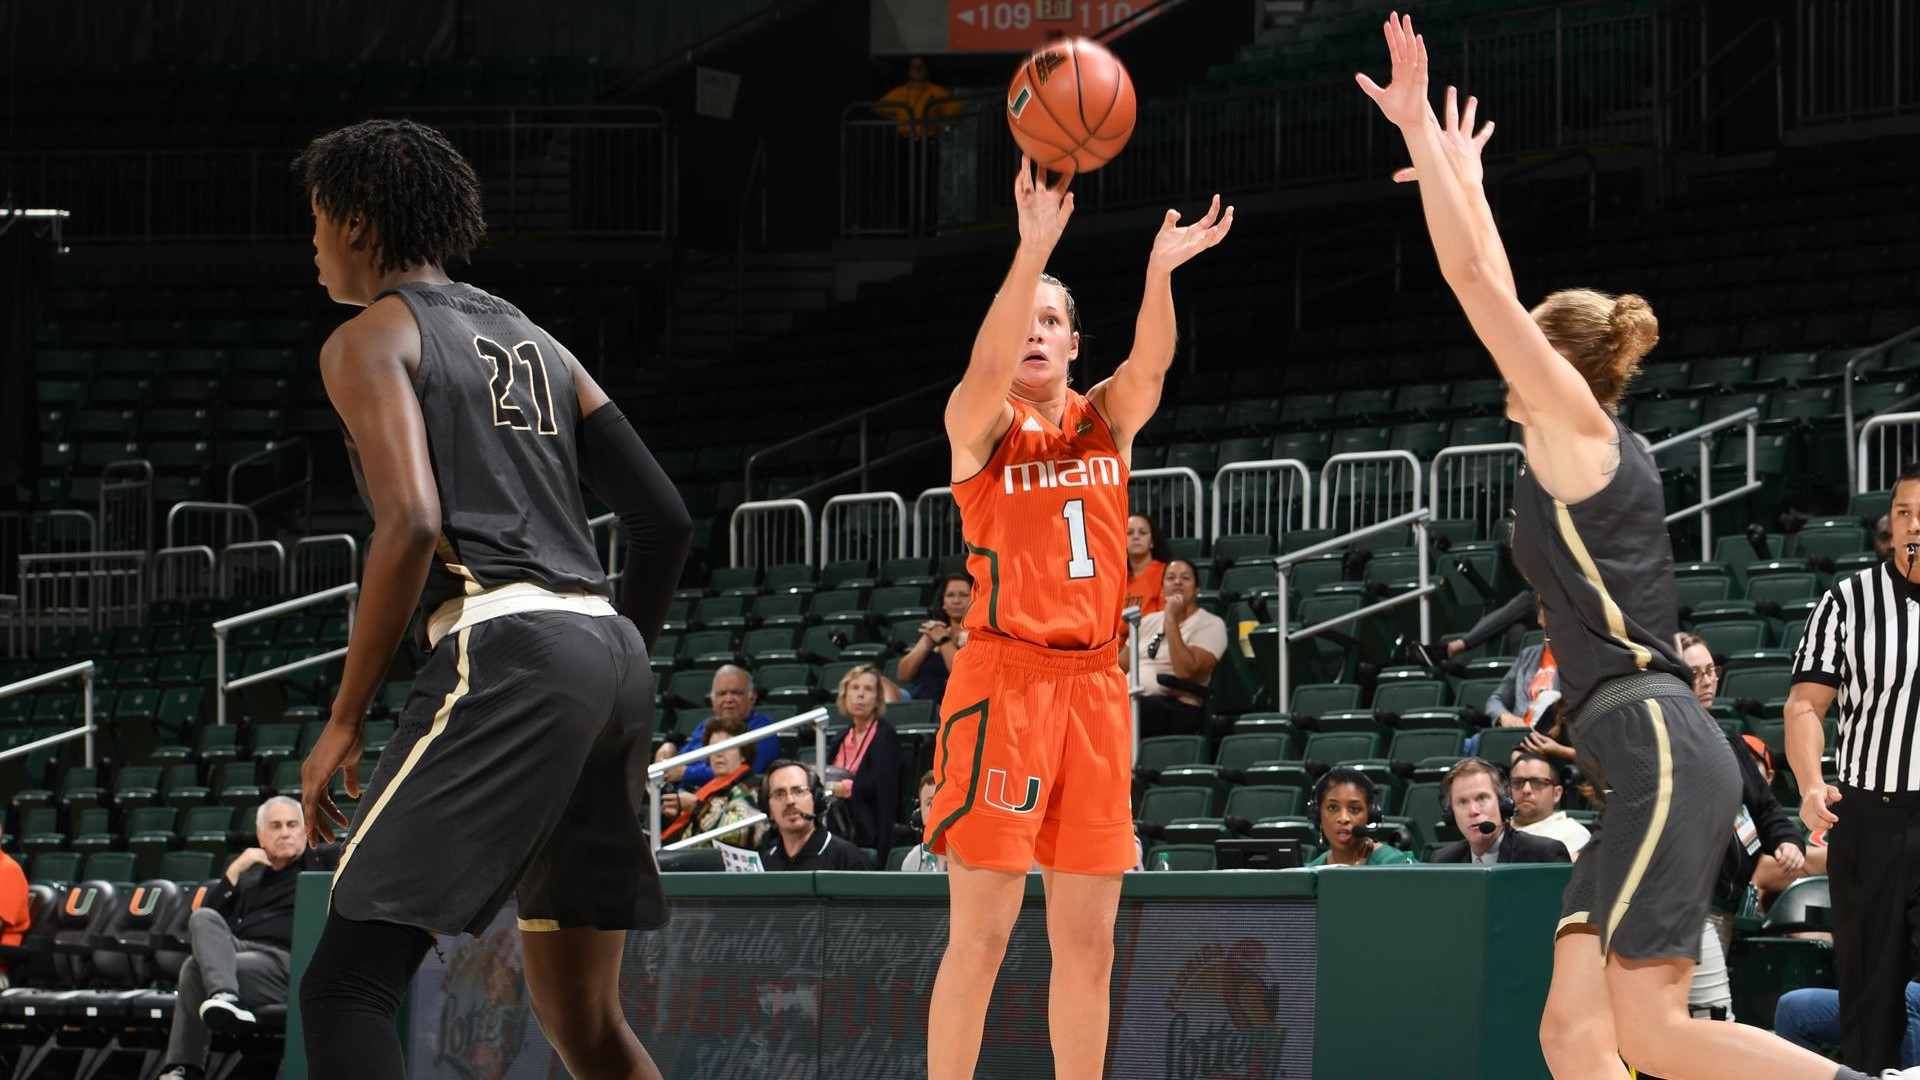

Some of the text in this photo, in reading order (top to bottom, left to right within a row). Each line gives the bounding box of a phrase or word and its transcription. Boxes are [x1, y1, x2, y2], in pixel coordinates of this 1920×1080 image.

[979, 4, 1031, 30] 109
[1080, 3, 1131, 29] 110
[473, 335, 557, 435] 21
[1003, 456, 1120, 495] MIAM
[1061, 498, 1096, 580] 1
[984, 768, 1041, 814] U
[65, 887, 97, 916] U
[129, 887, 161, 916] U
